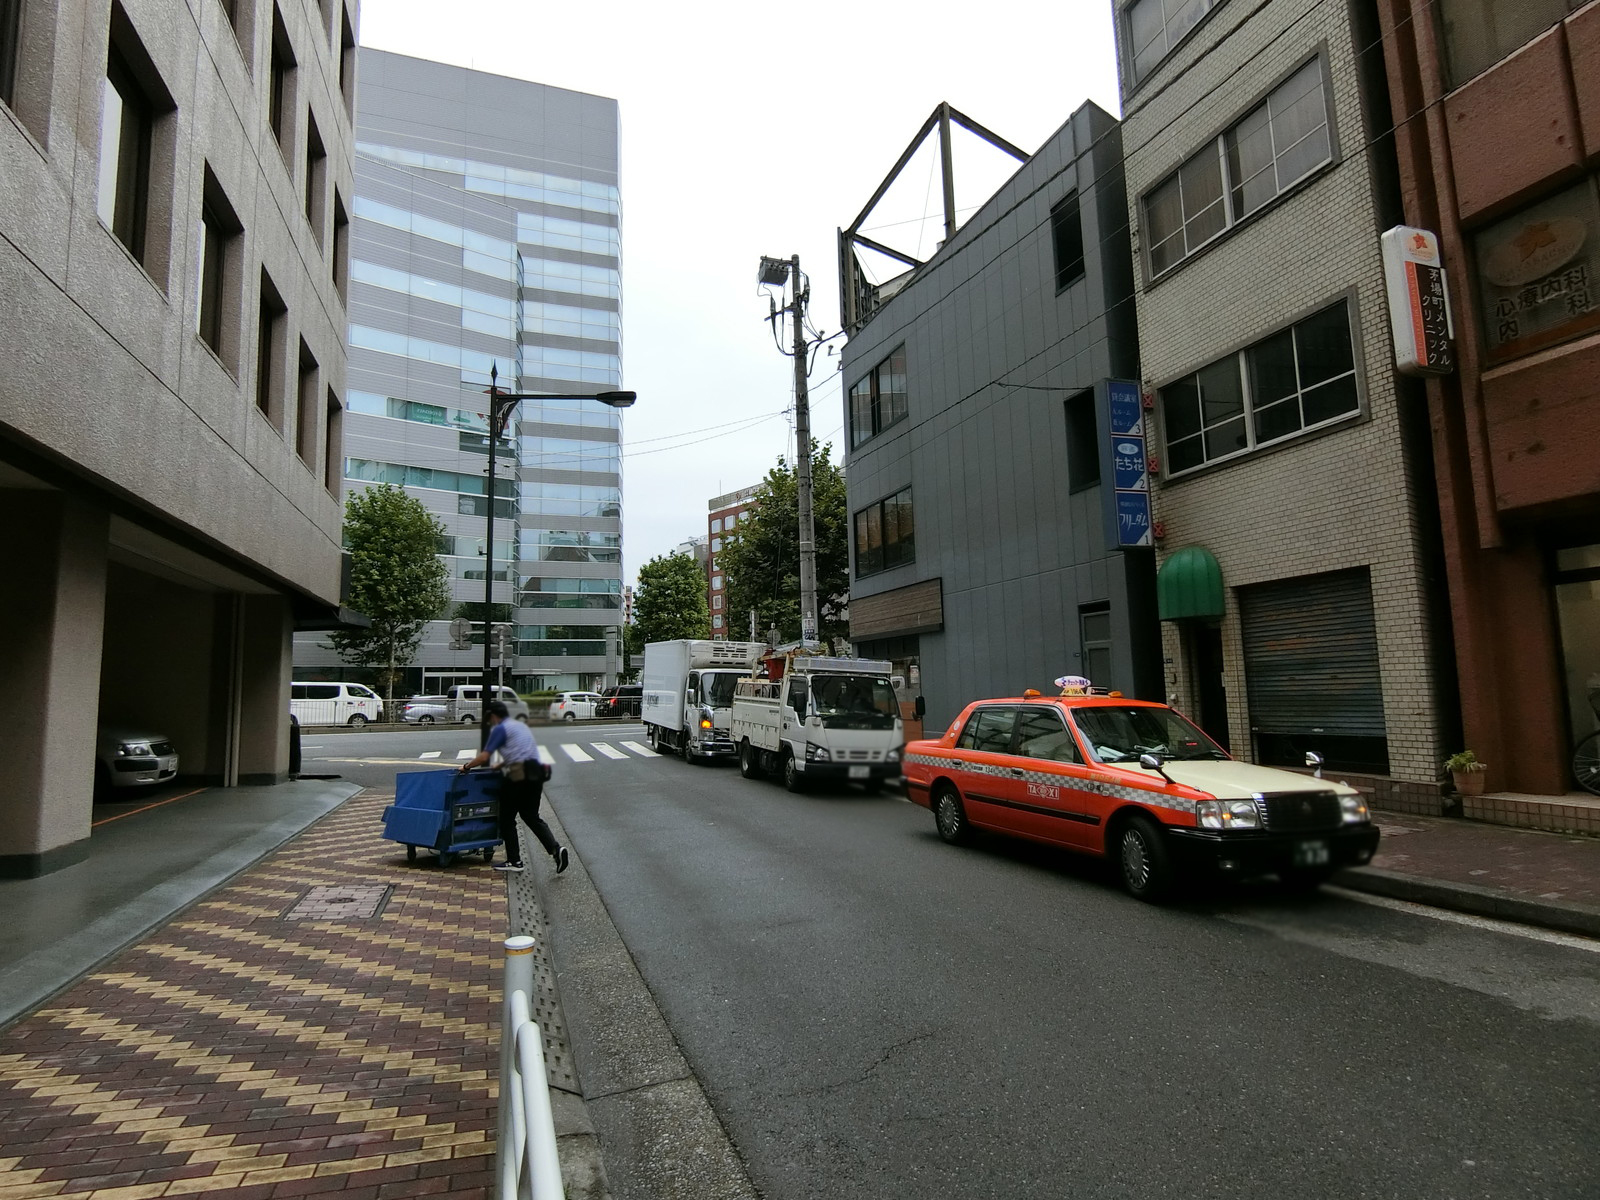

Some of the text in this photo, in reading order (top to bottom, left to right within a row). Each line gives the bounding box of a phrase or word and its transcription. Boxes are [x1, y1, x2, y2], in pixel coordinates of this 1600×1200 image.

[1495, 266, 1588, 318] 心療内科
[1428, 268, 1450, 365] 茅場町メンタル
[1422, 294, 1437, 365] クリニック
[1135, 423, 1141, 434] 3
[1114, 457, 1144, 471] たち花
[1140, 479, 1146, 489] 2
[1119, 512, 1149, 531] フリーダム
[1144, 534, 1150, 545] 1
